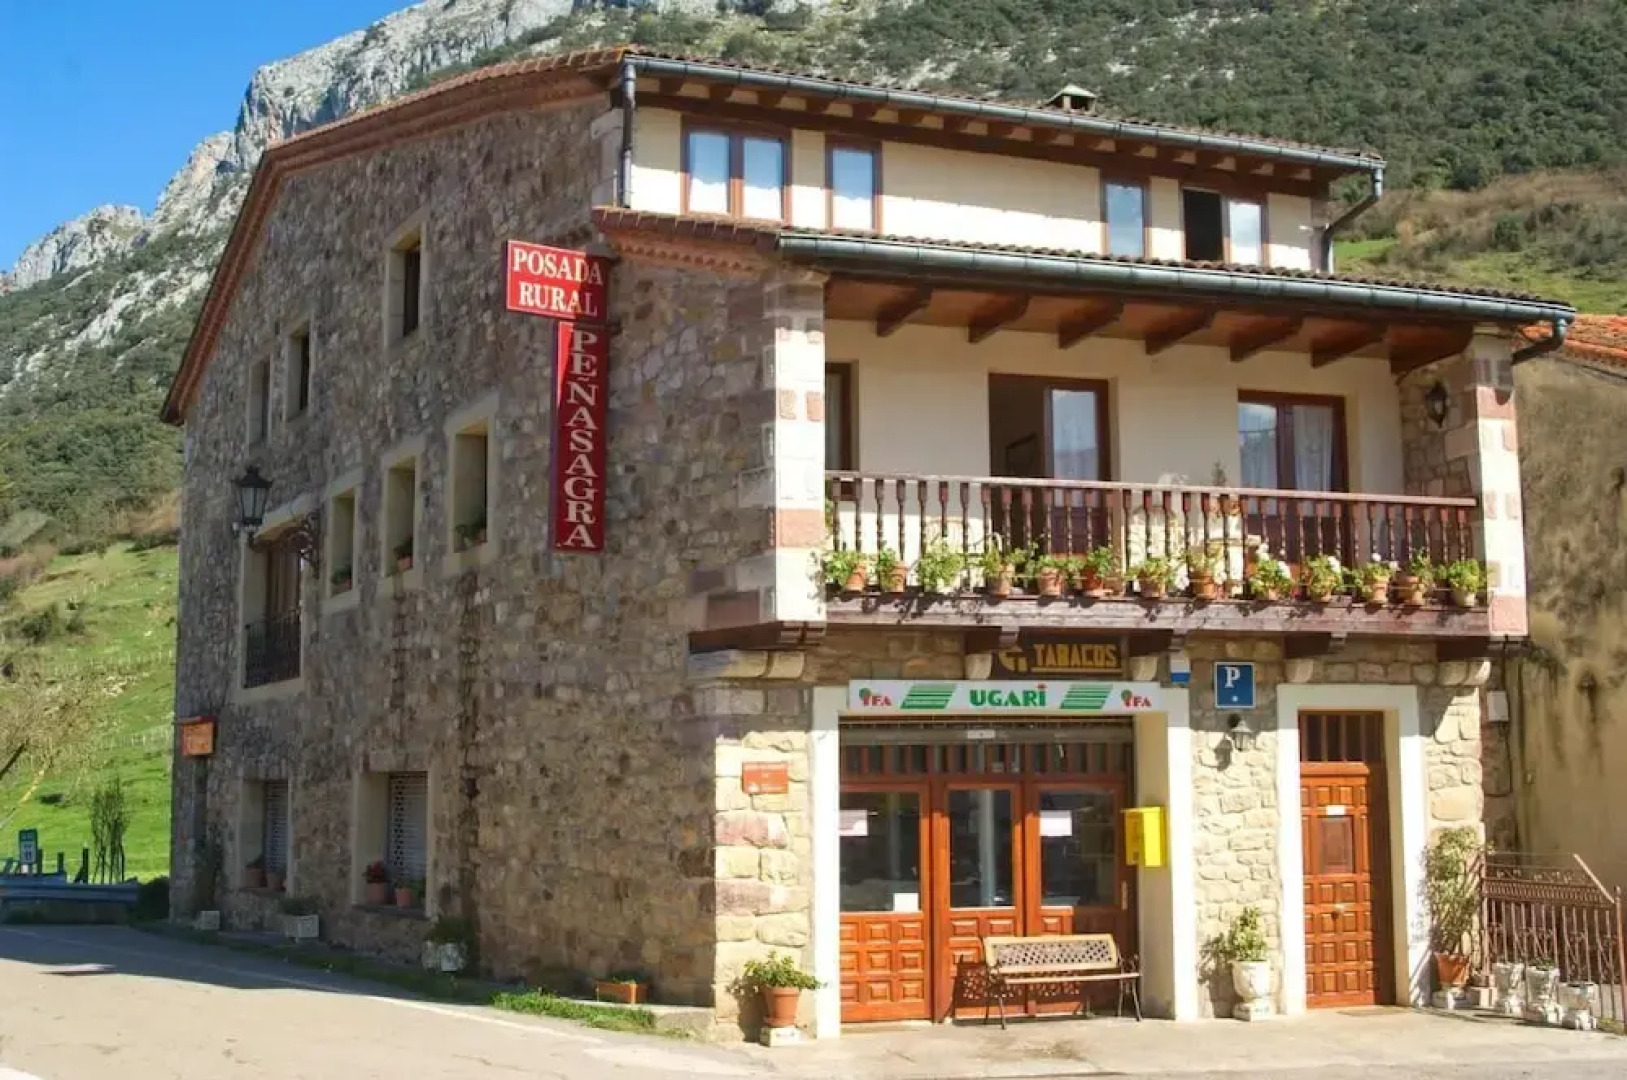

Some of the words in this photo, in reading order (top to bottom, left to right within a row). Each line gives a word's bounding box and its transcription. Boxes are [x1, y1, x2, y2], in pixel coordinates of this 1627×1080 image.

[513, 247, 603, 286] POSADA
[519, 280, 598, 316] RURAL
[1032, 643, 1118, 668] TABACOS
[1225, 666, 1241, 688] P
